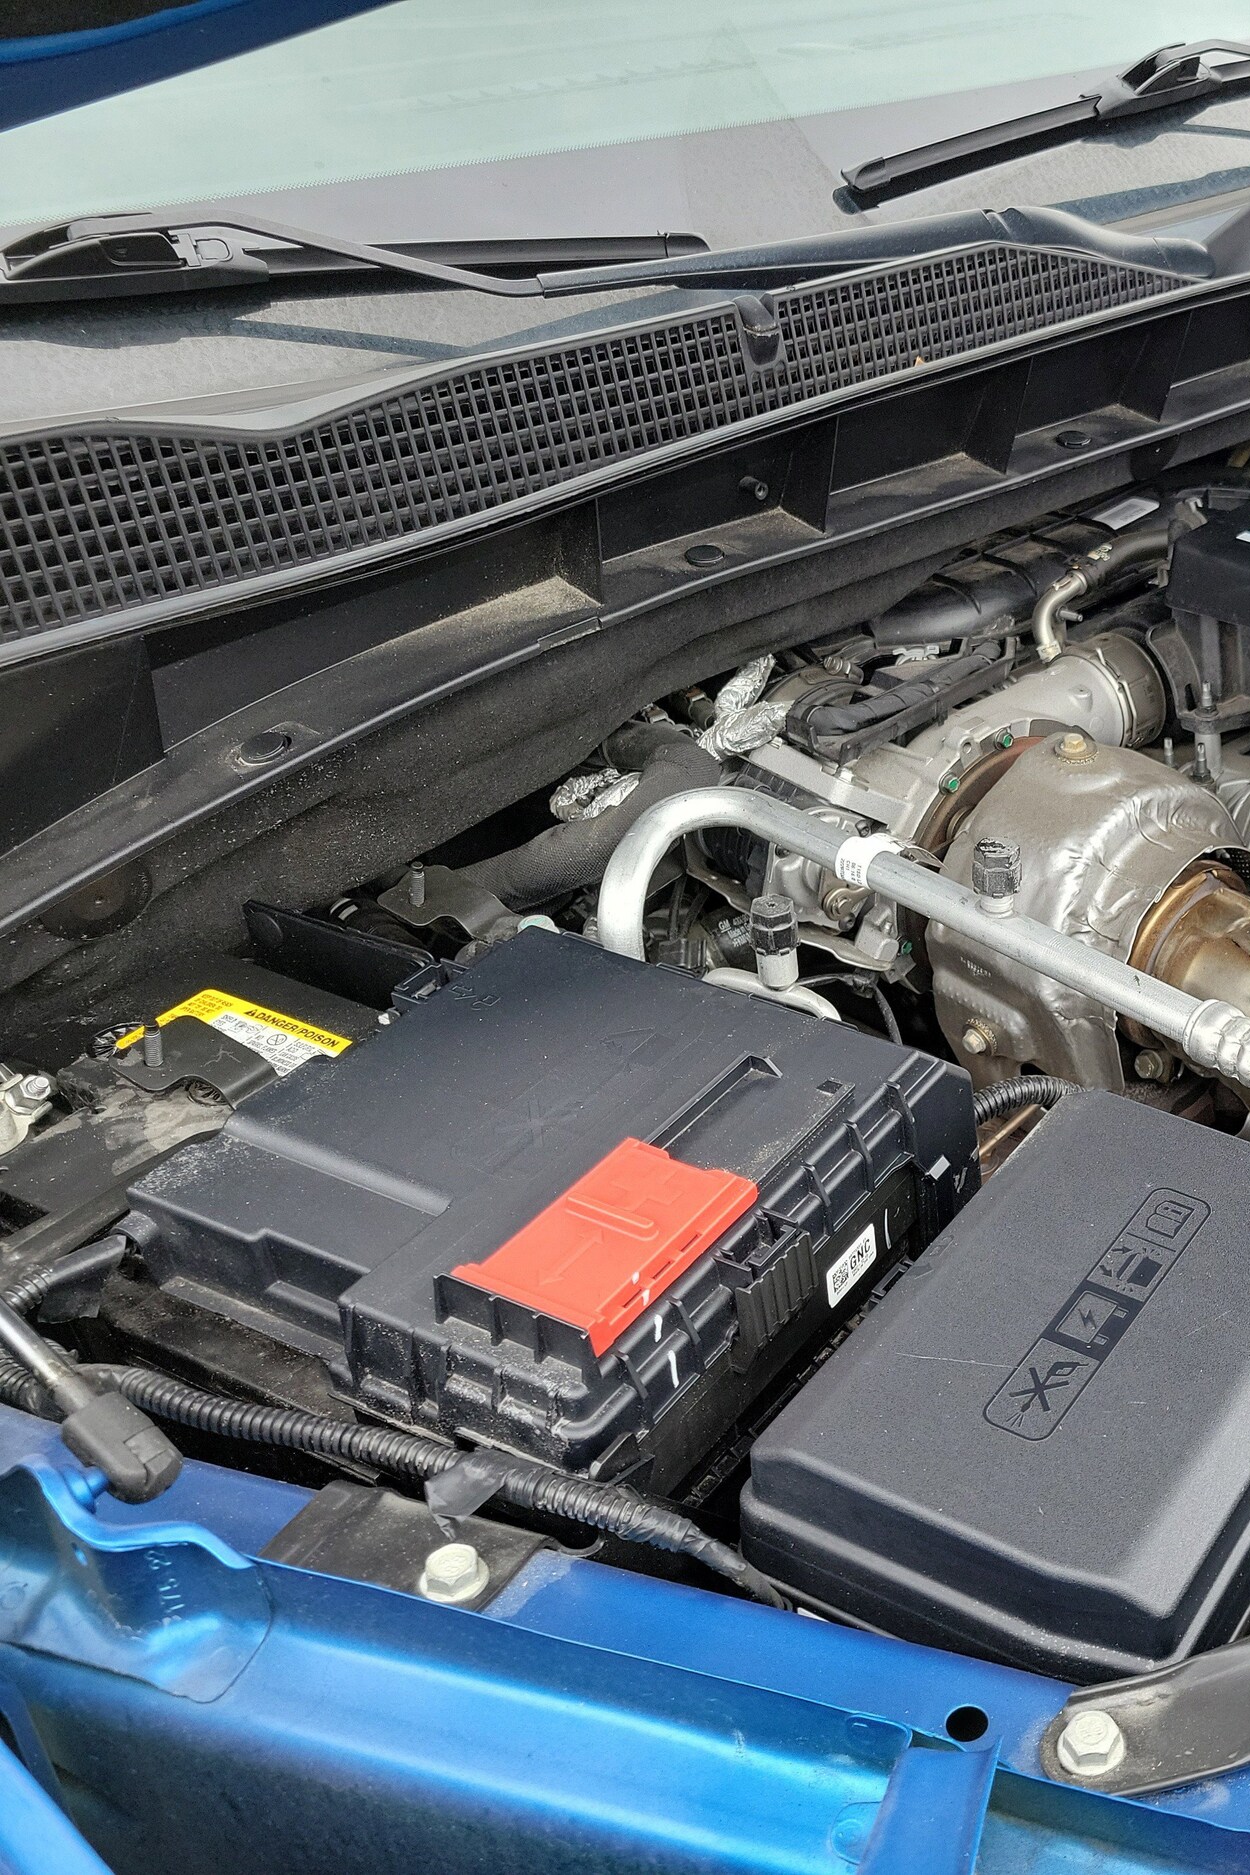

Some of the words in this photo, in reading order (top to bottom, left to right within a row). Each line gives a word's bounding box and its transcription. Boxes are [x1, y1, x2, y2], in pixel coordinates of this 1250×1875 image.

[718, 919, 732, 933] GM
[254, 1011, 339, 1049] DANGER/POISON
[849, 1240, 872, 1270] GNC
